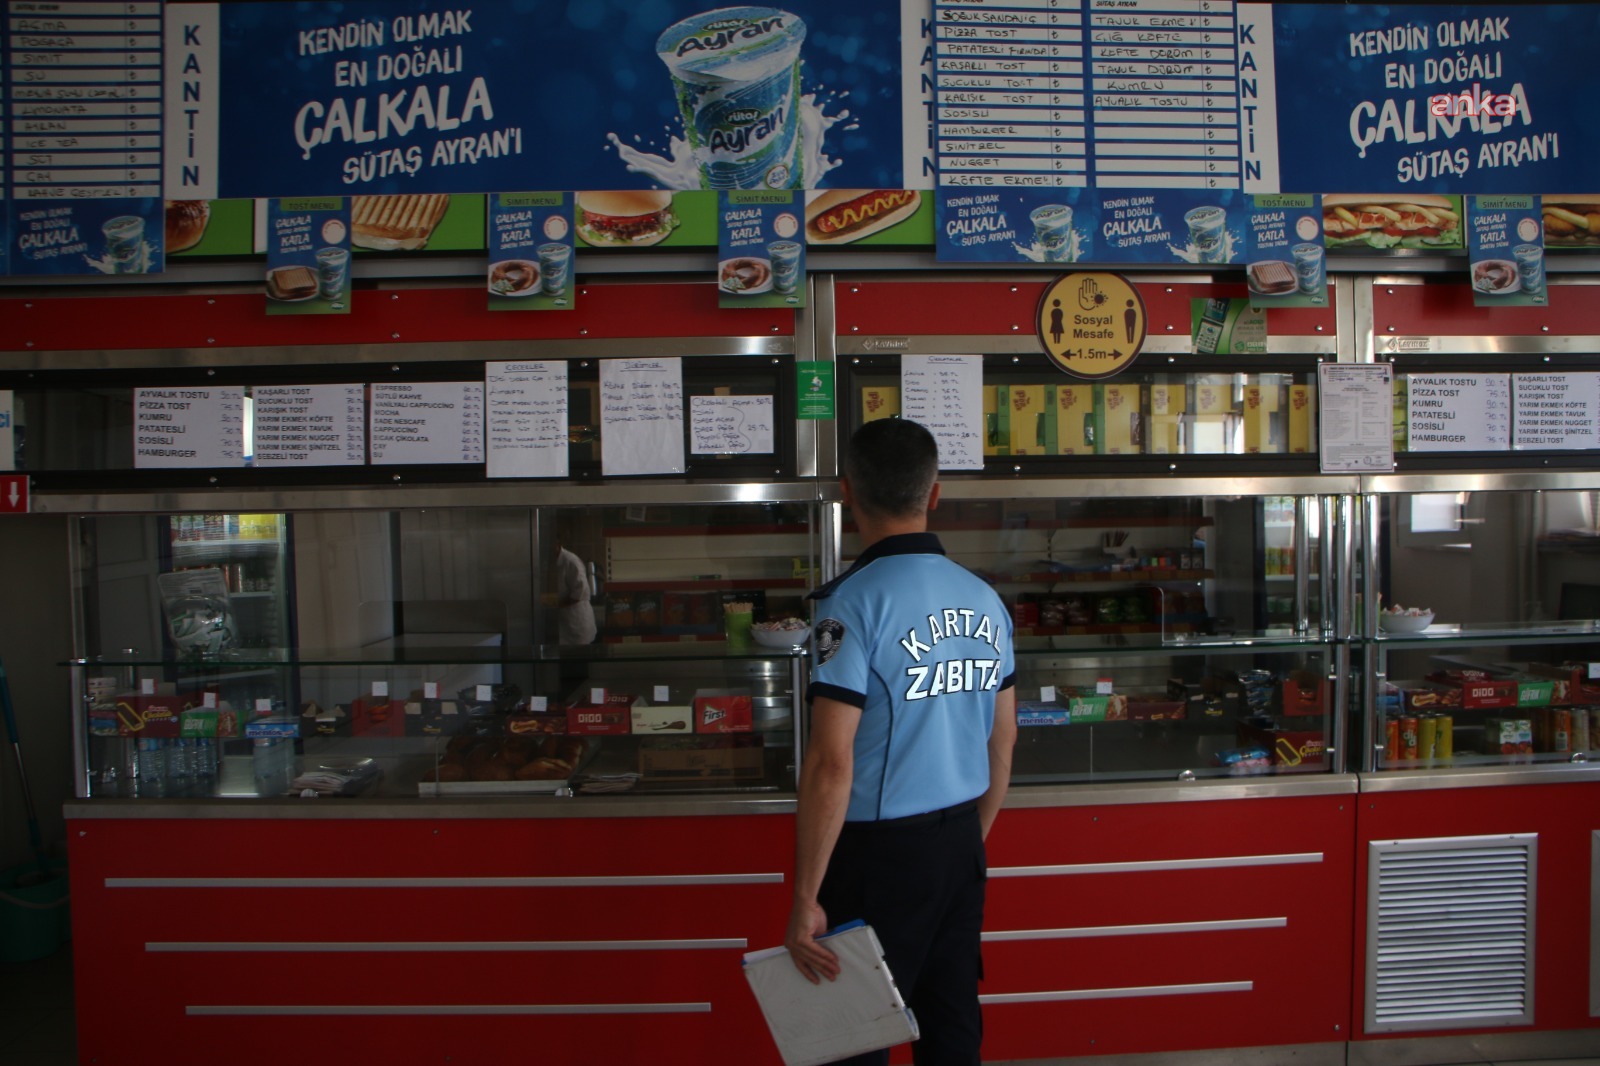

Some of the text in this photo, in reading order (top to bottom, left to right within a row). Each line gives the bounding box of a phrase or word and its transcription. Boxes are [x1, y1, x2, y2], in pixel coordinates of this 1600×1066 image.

[1095, 17, 1140, 25] TAVUK
[299, 10, 472, 56] KENDİN OLMAK
[677, 18, 783, 57] Ayran
[986, 29, 1017, 38] TOST
[1350, 16, 1510, 57] KENDİN OLMAK
[335, 45, 463, 87] EN DOĞALI
[996, 62, 1025, 71] TOST
[1385, 51, 1502, 89] EN DOĞALI
[24, 71, 46, 81] SU
[942, 78, 1034, 87] SUCUKLU TOST
[183, 25, 201, 186] KANTİN
[1150, 97, 1188, 105] TOSTU
[1239, 24, 1261, 180] KANTİN
[294, 76, 494, 160] ÇALKALA
[711, 107, 783, 154] Ayran
[944, 126, 1017, 135] HAMBURGER
[342, 128, 522, 184] SÜTAŞ AYRAN'I
[1397, 132, 1559, 183] SÜTAŞ AYRAN'I
[950, 158, 999, 166] NUGGET
[949, 175, 994, 185] KÖFTE
[947, 194, 999, 208] KENDİN OLMAK
[1131, 196, 1154, 206] OLMAK
[1262, 199, 1280, 207] TOST
[958, 208, 969, 217] EN
[1114, 210, 1124, 219] EN
[946, 214, 1007, 239] ÇALKALA
[1103, 216, 1162, 240] ÇALKALA
[731, 226, 760, 240] KATLA
[1258, 229, 1285, 242] KATLA
[1480, 230, 1506, 243] KATLA
[961, 236, 986, 247] SÜTAŞ
[1074, 314, 1113, 327] Sosyal
[1073, 328, 1114, 339] Mesafe
[1077, 348, 1107, 359] 1.5m
[1412, 378, 1447, 386] AYVALIK
[140, 391, 210, 399] AYVALIK TOSTU
[167, 402, 191, 410] TOST
[138, 413, 172, 421] KUMRU
[1412, 411, 1455, 419] PATATESLİ
[1412, 422, 1445, 430] SOSİSLİ
[1412, 434, 1466, 442] HAMBURGER
[138, 448, 197, 458] HAMBURGER
[901, 608, 1001, 662] KARTAL
[906, 659, 1001, 701] ZABITA
[703, 707, 726, 724] First
[1020, 715, 1054, 725] mentos
[250, 728, 283, 738] mentos
